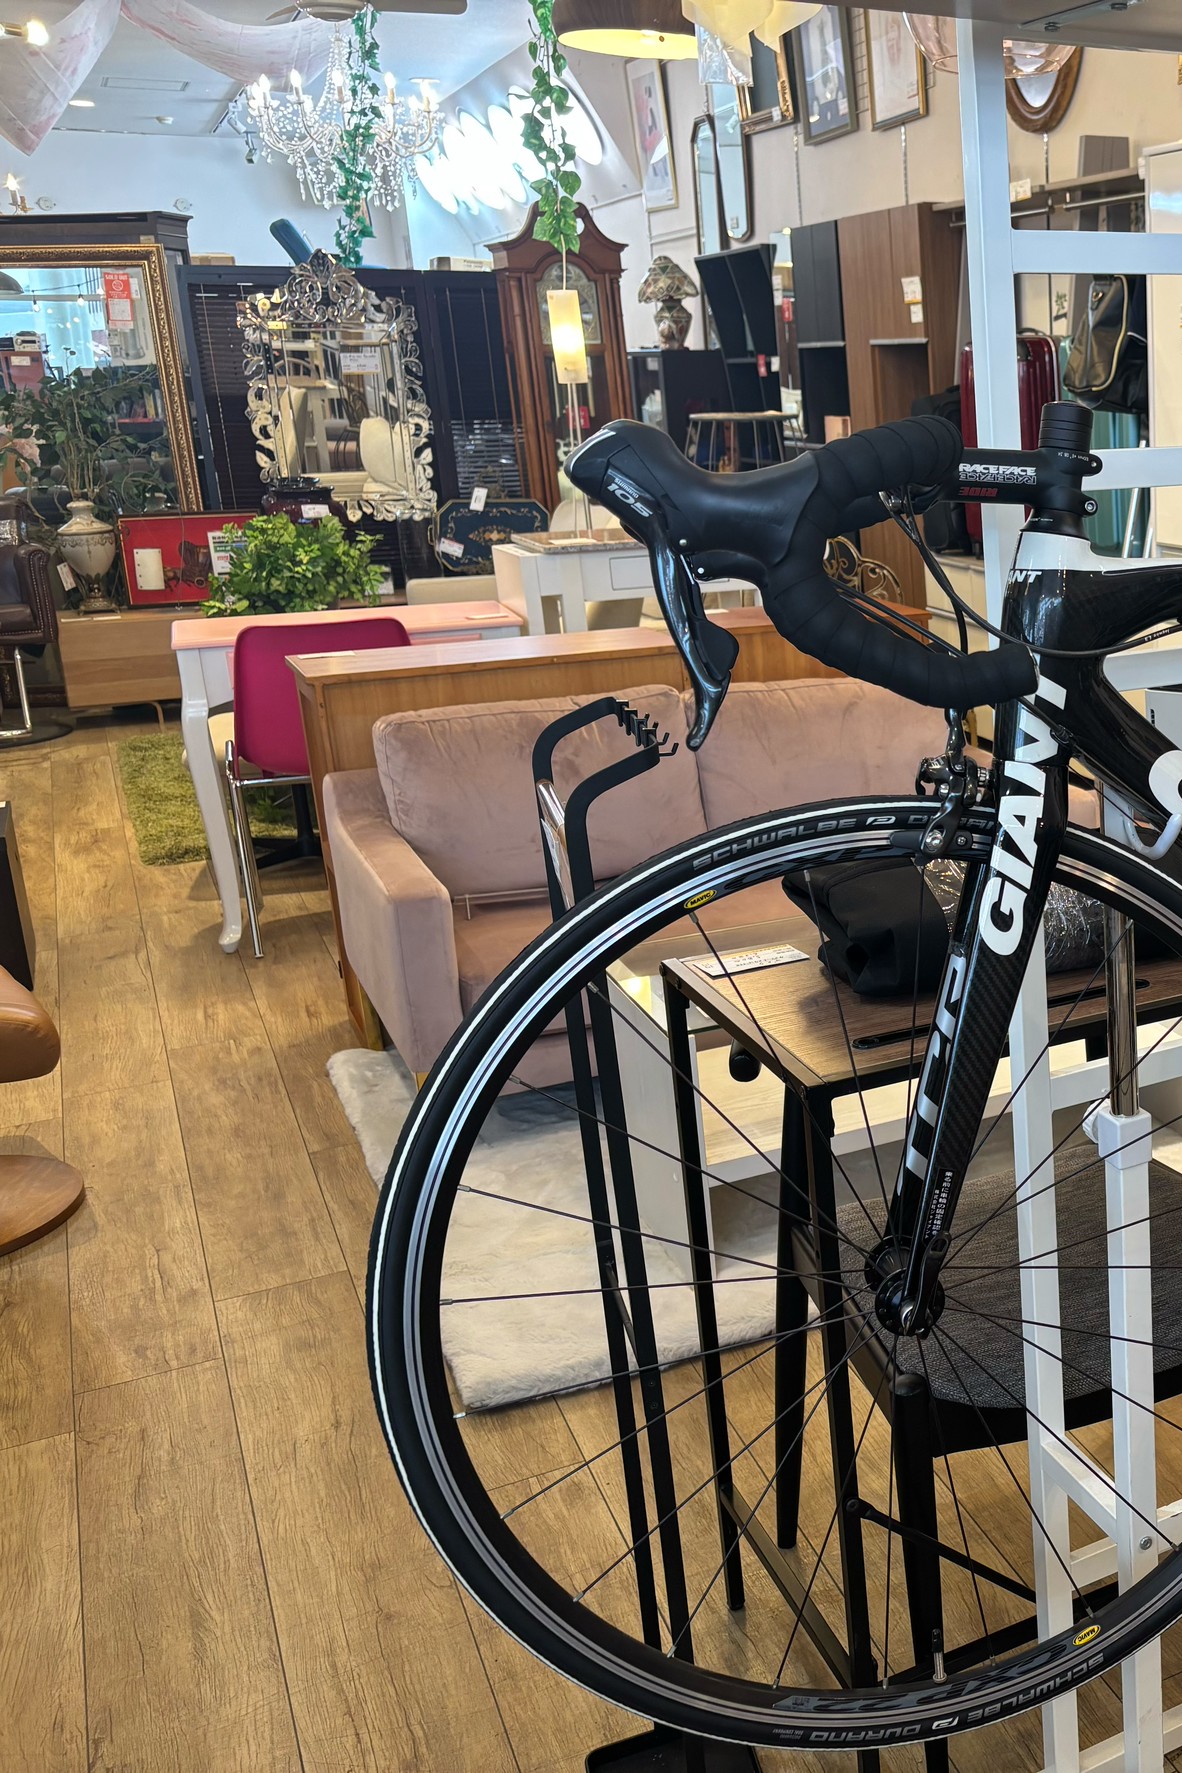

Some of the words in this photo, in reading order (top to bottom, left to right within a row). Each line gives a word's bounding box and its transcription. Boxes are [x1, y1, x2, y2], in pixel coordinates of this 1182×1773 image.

[958, 462, 1036, 475] RACEFACE
[607, 483, 653, 518] 105
[958, 486, 998, 497] RIDE
[692, 818, 857, 872] SCHWALBE
[689, 892, 713, 906] MAVIC
[1076, 1626, 1100, 1643] MAVIC
[967, 1652, 1104, 1723] SCHWALBE
[810, 1724, 921, 1743] DURANO
